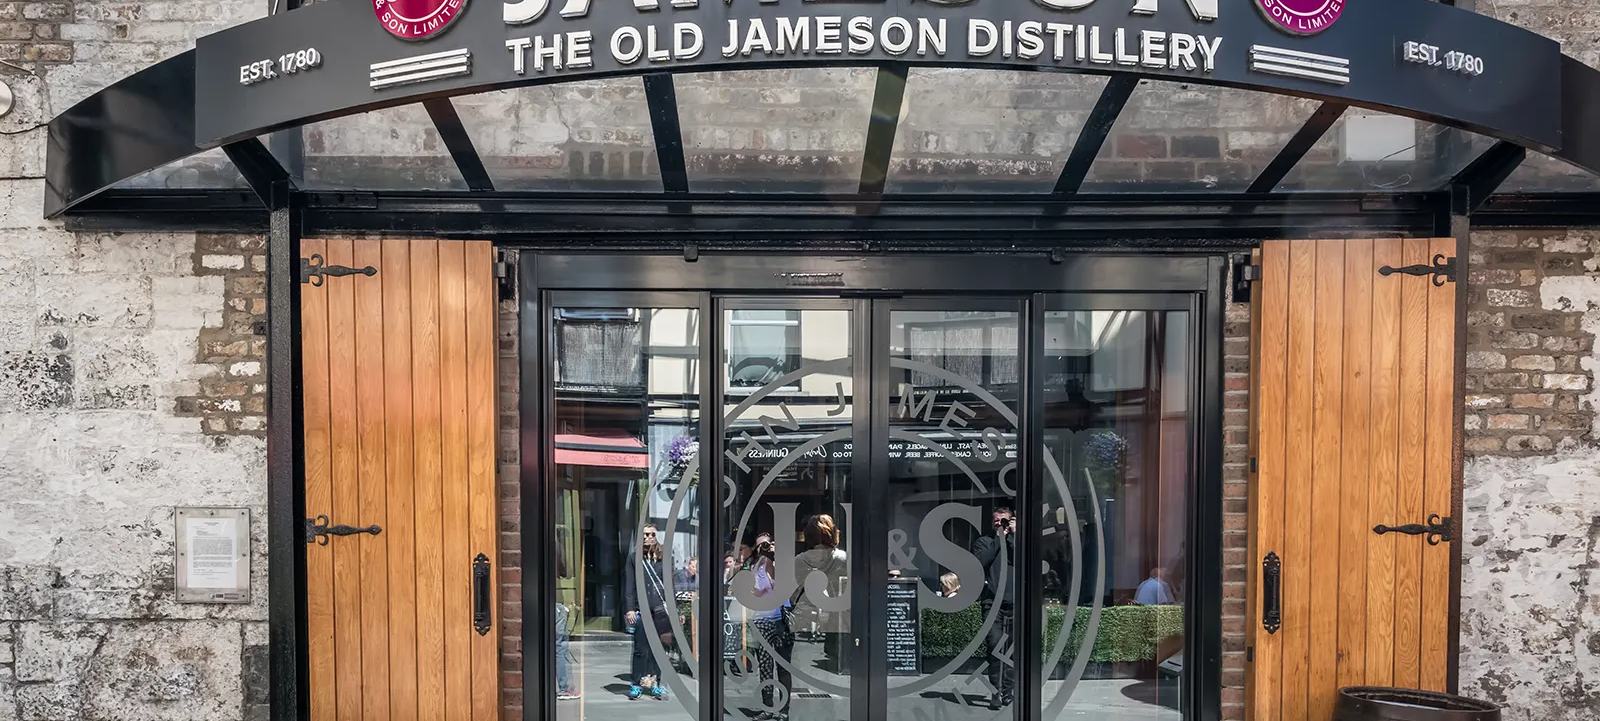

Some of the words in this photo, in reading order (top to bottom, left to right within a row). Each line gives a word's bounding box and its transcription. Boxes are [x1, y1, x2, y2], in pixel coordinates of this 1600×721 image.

[382, 12, 408, 34] SON
[413, 0, 460, 34] LIMITE
[1264, 0, 1293, 25] SON
[505, 29, 593, 75] THE
[610, 22, 704, 65] OLD
[721, 15, 947, 57] JAMESON
[967, 18, 1224, 73] DISTILLERY
[1404, 41, 1442, 66] EST.
[1444, 50, 1484, 76] 1780
[240, 59, 278, 85] EST.
[278, 47, 321, 74] 1780
